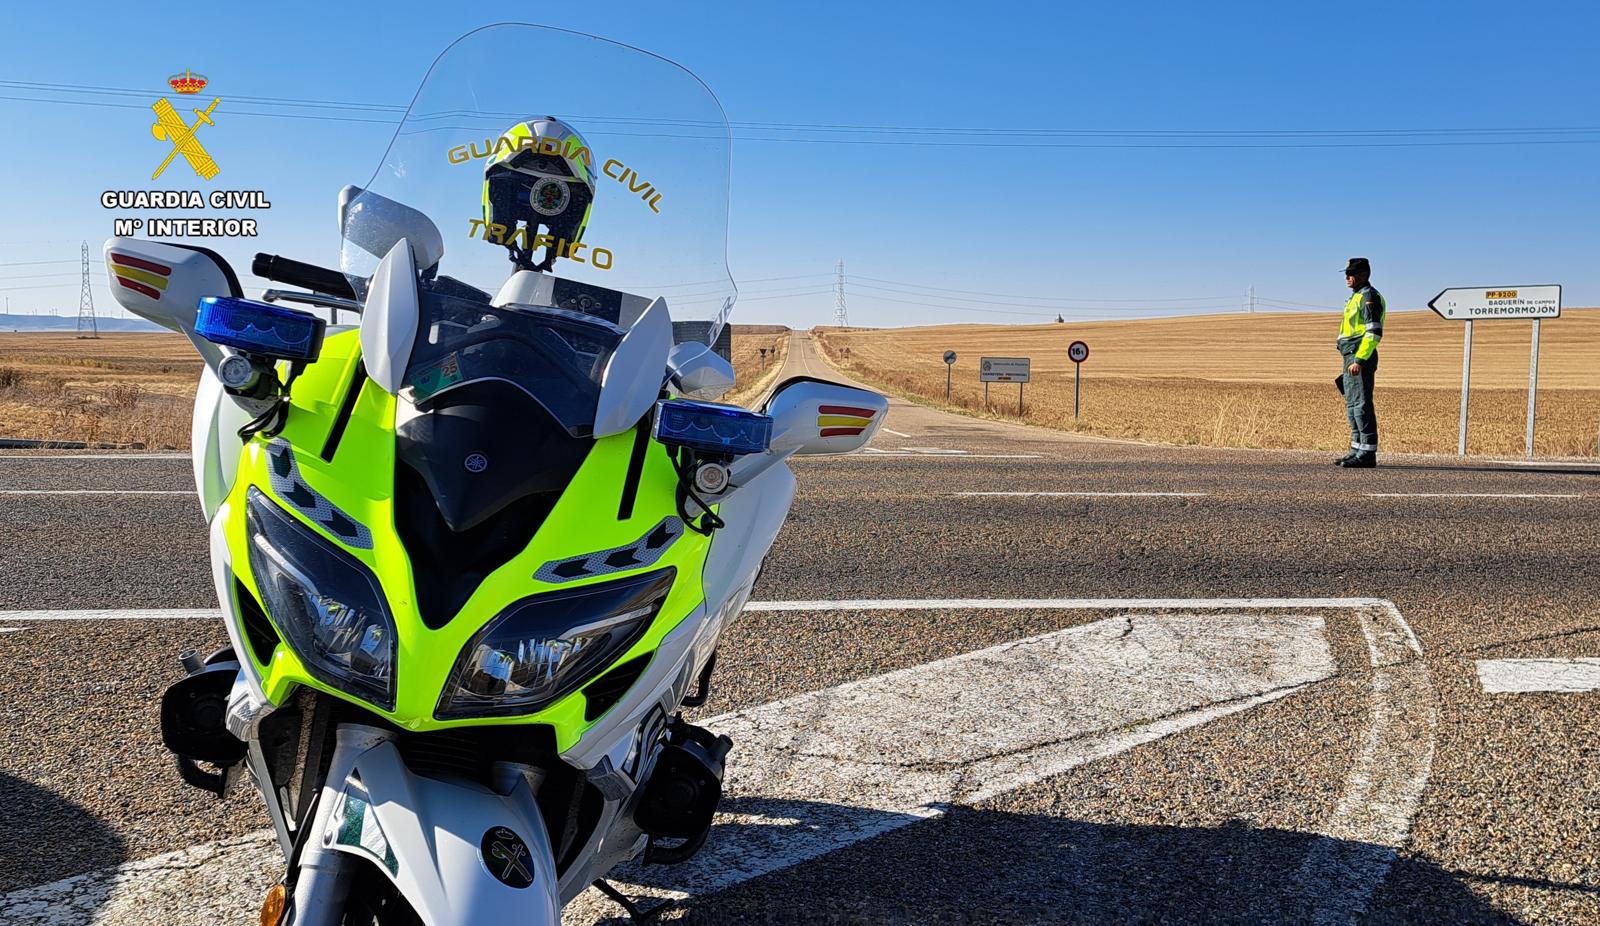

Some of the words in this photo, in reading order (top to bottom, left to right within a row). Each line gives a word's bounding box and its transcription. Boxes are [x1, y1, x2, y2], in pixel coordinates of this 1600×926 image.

[447, 135, 592, 165] GUARDIA
[602, 158, 665, 214] CIVIL
[1469, 305, 1556, 316] TORREMORMOJÓN
